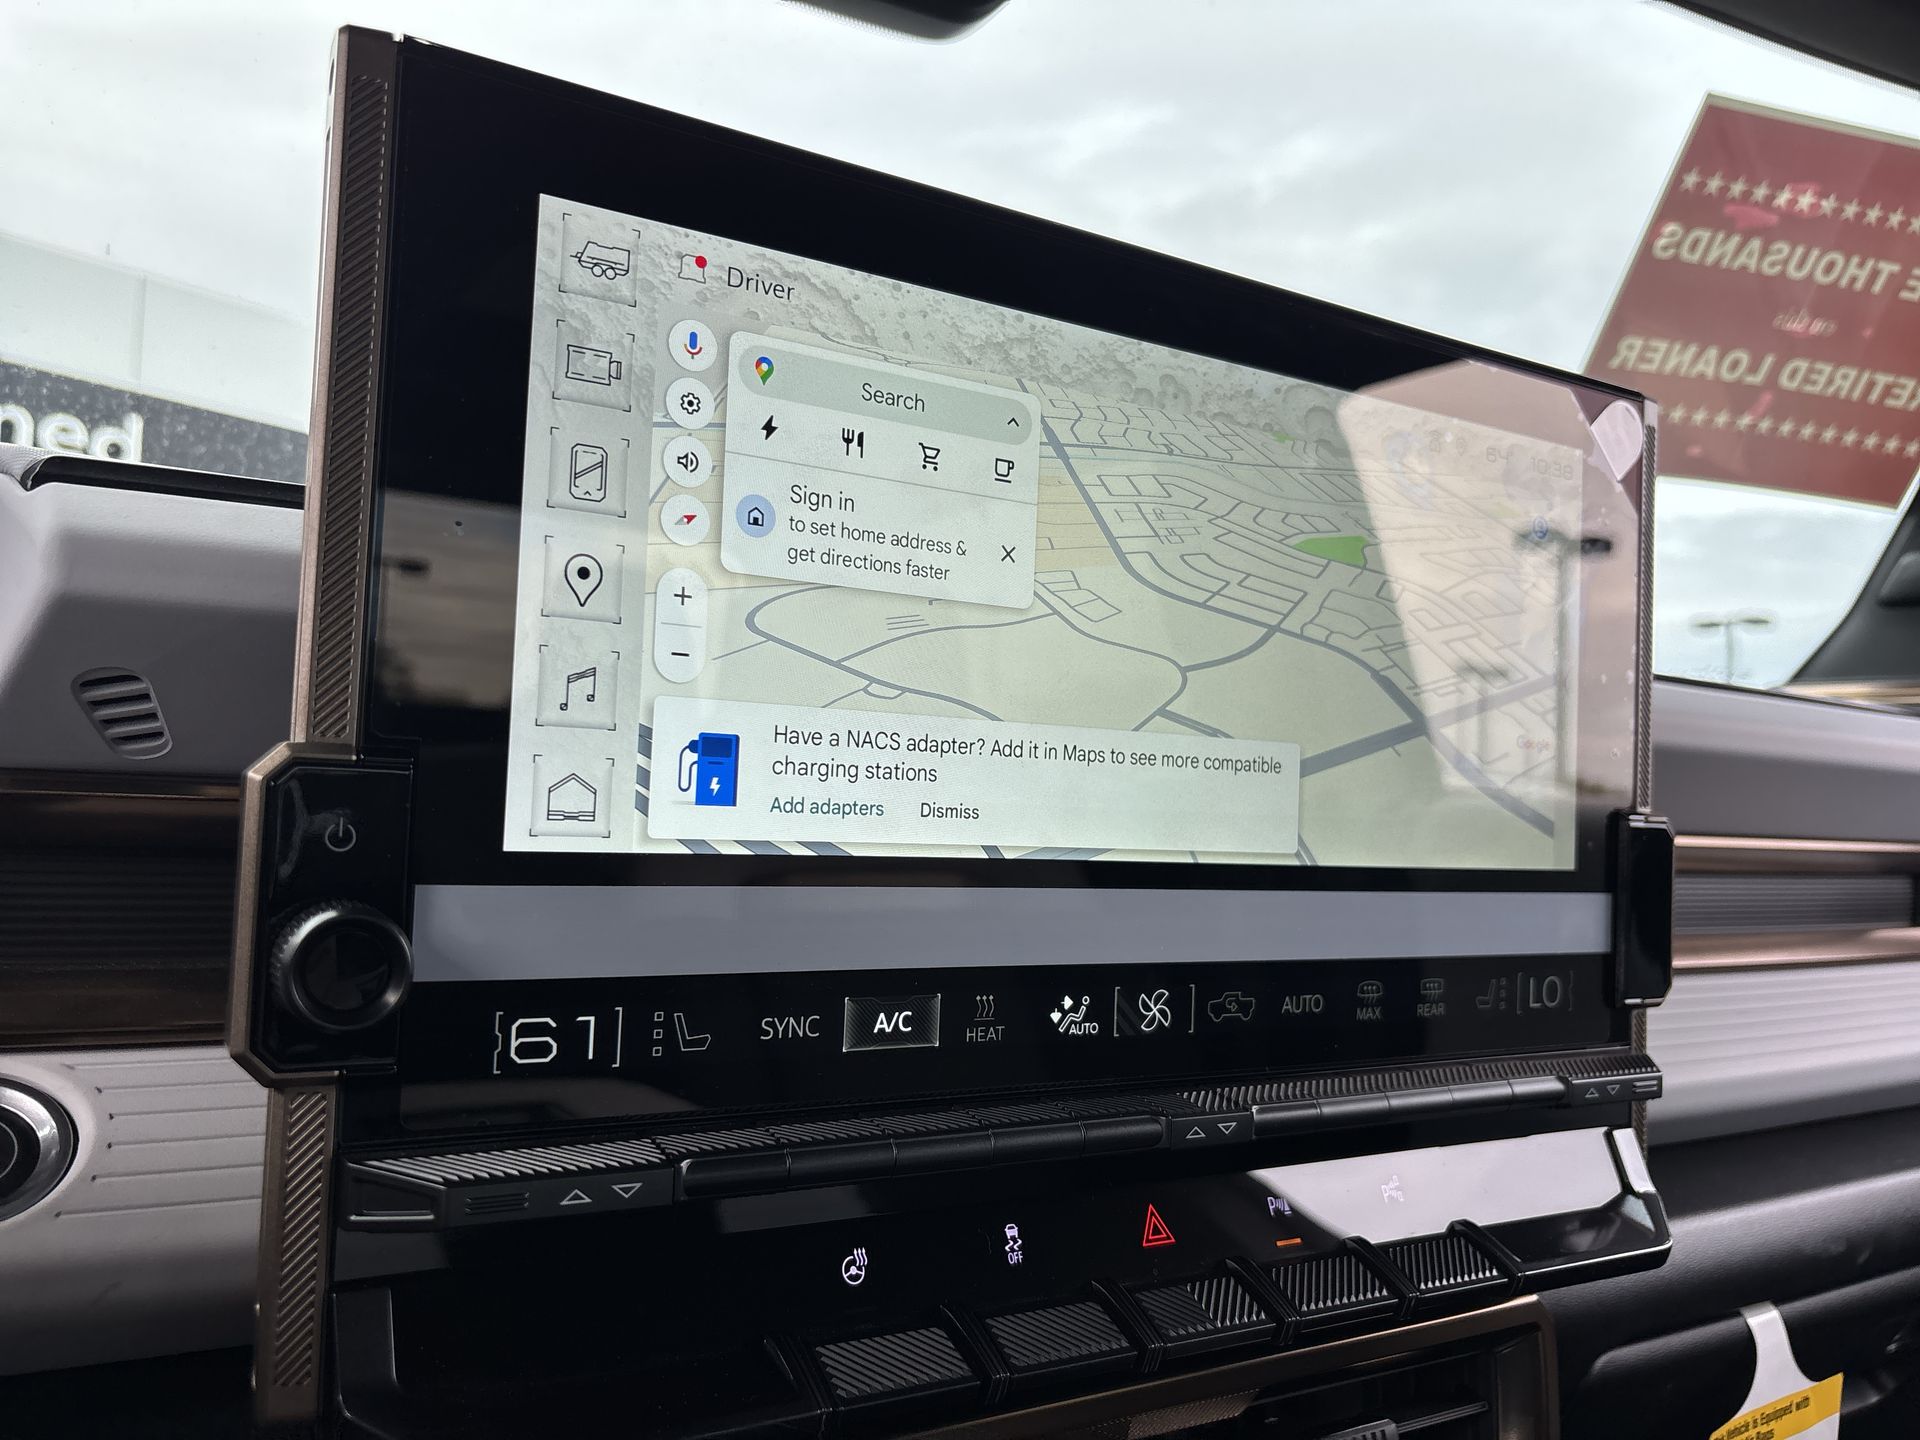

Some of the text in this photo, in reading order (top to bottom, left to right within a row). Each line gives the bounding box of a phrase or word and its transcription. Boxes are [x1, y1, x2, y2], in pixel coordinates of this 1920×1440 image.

[727, 266, 795, 301] Driver
[861, 382, 925, 412] Search
[789, 484, 855, 513] Sign in
[789, 515, 968, 556] to set home address &
[787, 545, 950, 581] get directions faster
[773, 725, 1282, 775] Have a NACS adapter? Add it in Maps to see more compatible
[772, 756, 938, 783] charging stations
[770, 796, 981, 821] Add adapters Dismiss
[1281, 993, 1324, 1015] AUTO
[1528, 975, 1562, 1010] LO
[874, 1010, 913, 1034] A/C
[1356, 1006, 1383, 1022] MAX
[1416, 1002, 1445, 1018] REAR
[510, 1016, 598, 1064] 61
[760, 1015, 821, 1041] SYNC
[966, 1025, 1005, 1043] HEAT
[1069, 1022, 1099, 1035] AUTO
[1007, 1250, 1024, 1266] OFF
[1760, 1401, 1793, 1426] Equipped
